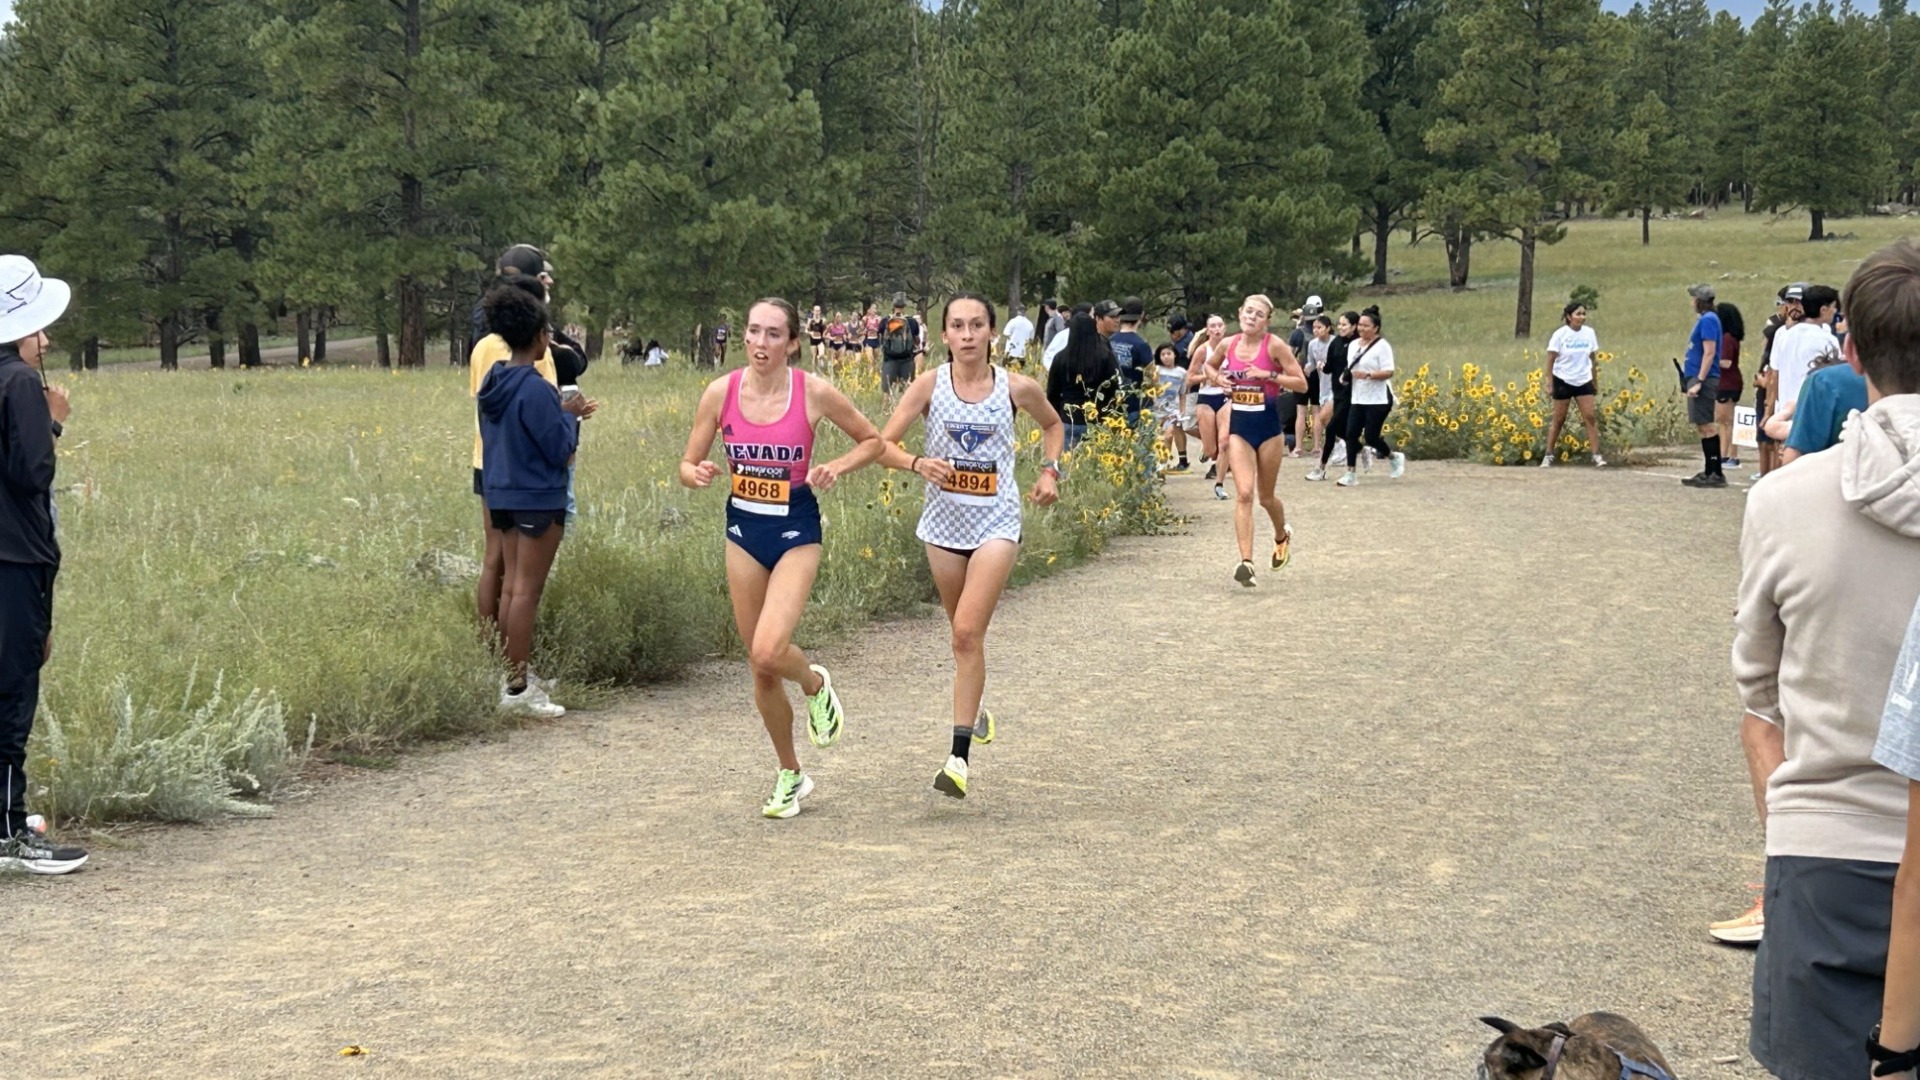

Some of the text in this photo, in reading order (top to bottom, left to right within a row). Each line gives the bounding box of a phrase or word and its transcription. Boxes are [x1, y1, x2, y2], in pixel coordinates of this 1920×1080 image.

[724, 443, 804, 462] NEVADA
[738, 479, 781, 498] 4968
[946, 474, 991, 492] 4894
